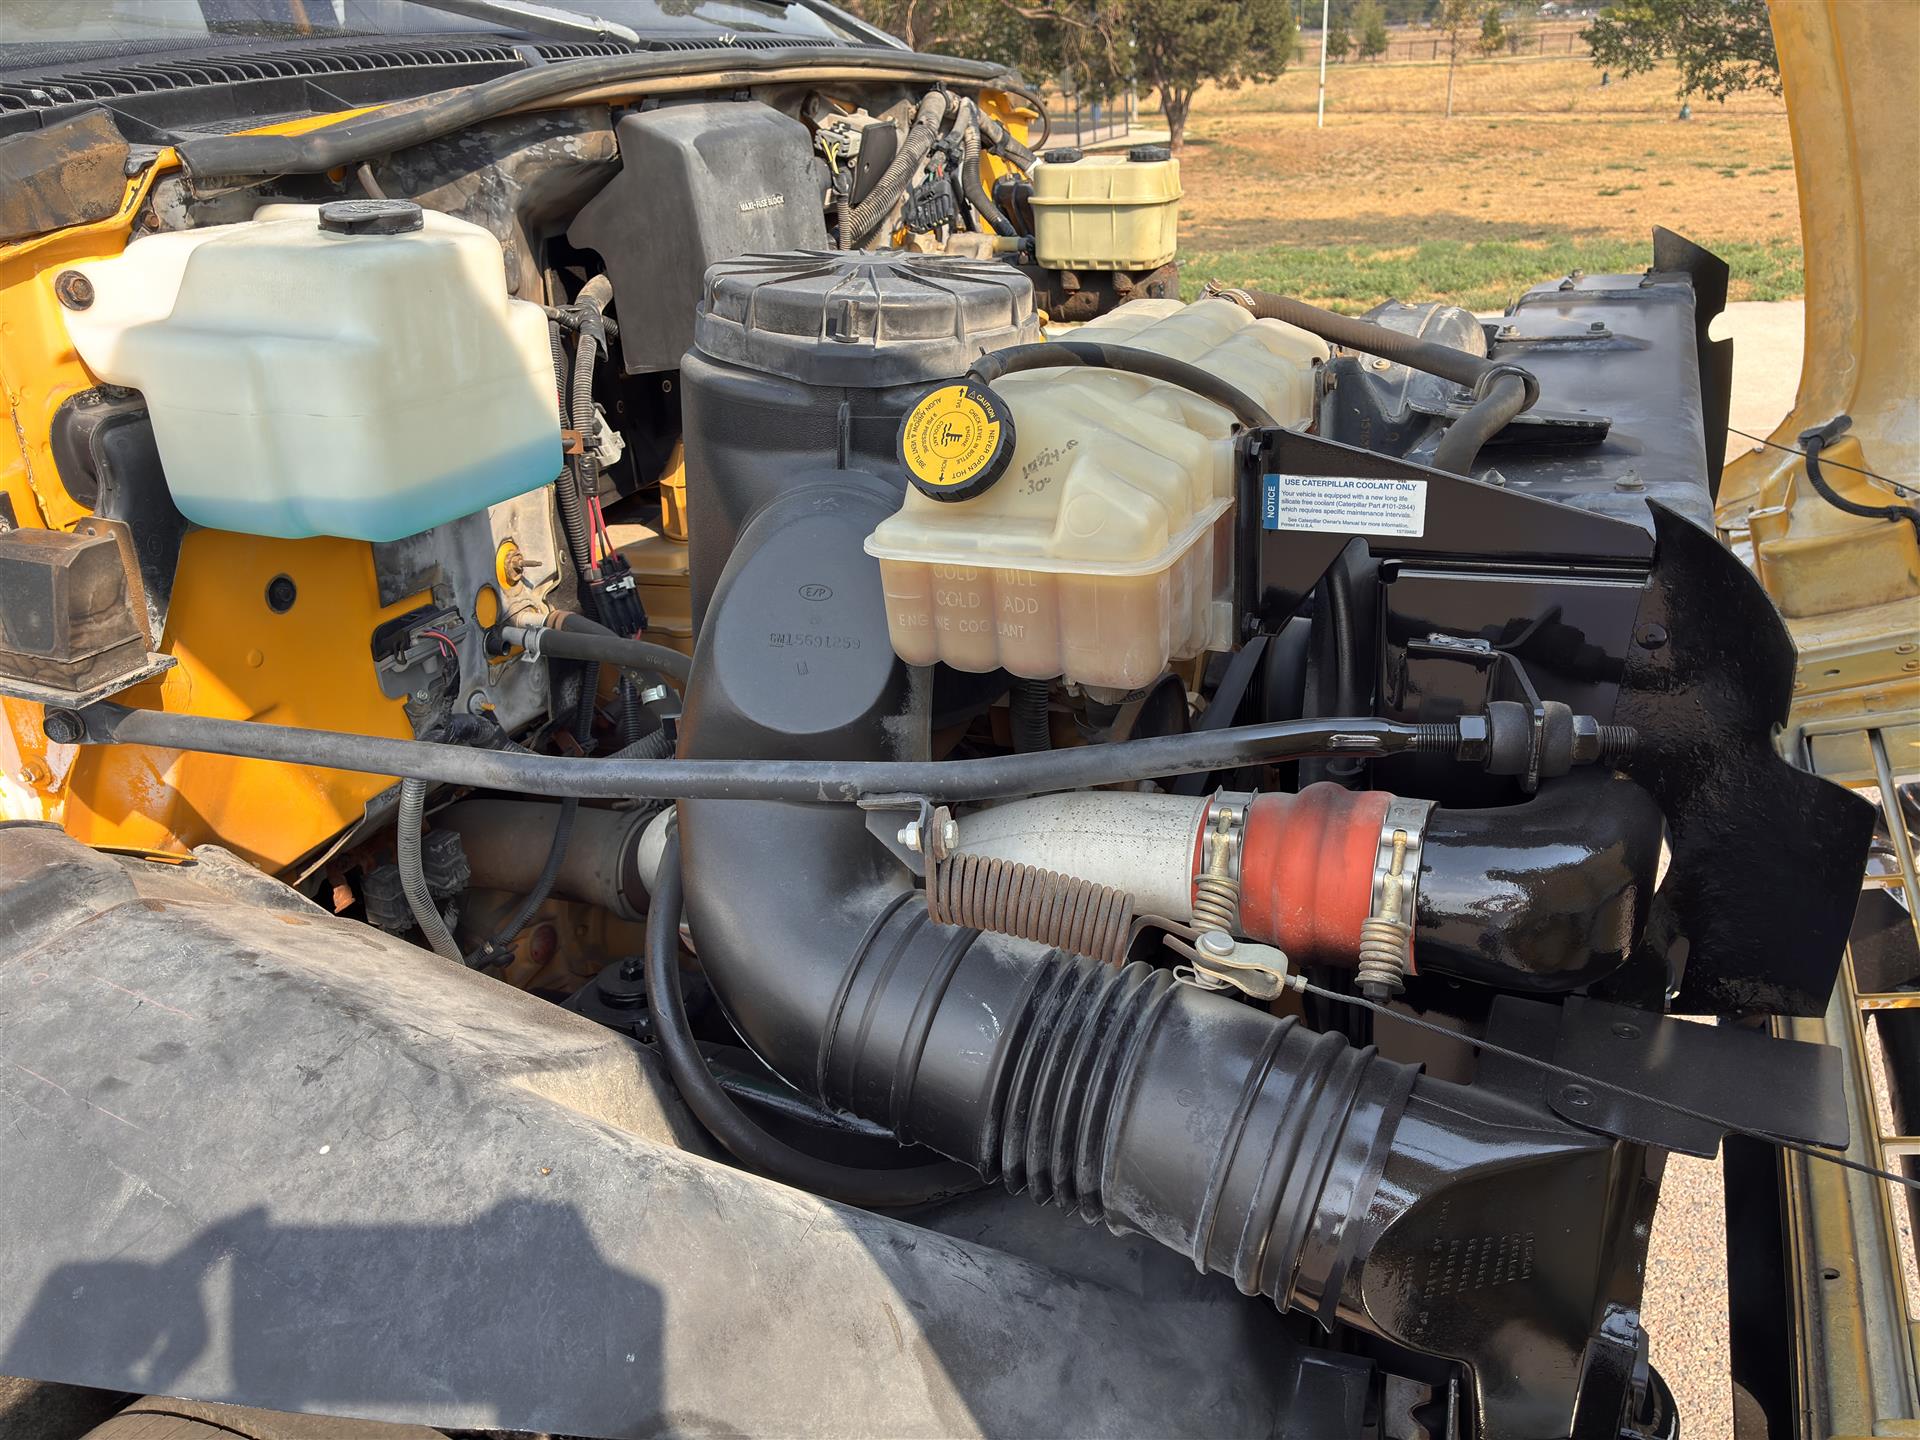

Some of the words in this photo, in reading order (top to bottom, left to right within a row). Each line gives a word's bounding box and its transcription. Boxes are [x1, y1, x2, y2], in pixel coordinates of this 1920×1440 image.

[925, 397, 942, 411] ALIGN
[976, 394, 996, 419] CAUTION
[912, 410, 926, 432] ARROW
[969, 408, 981, 425] CHECK
[921, 425, 930, 454] PRESSURE
[933, 420, 944, 447] COOLANT
[961, 425, 971, 447] ENGINE
[975, 425, 983, 441] LEVEL
[984, 429, 996, 454] NEVER
[915, 455, 926, 469] TUBE
[956, 449, 975, 465] BOTTLE
[968, 454, 985, 472] OPEN
[952, 469, 967, 479] HOT
[1284, 478, 1300, 486] USE
[1301, 479, 1355, 488] CATERPILLAR
[1356, 481, 1395, 490] COOLANT
[1395, 483, 1417, 491] ONLY
[1266, 485, 1276, 518] NOTICE
[1323, 492, 1351, 501] equipped
[1384, 494, 1398, 502] long
[1335, 500, 1368, 509] (Caterpillar
[1381, 502, 1416, 511] #101-2844)
[1298, 507, 1322, 515] requires
[1323, 508, 1345, 516] specific
[1346, 509, 1384, 517] maintenance
[1298, 517, 1322, 525] Caterpillar
[933, 564, 978, 582] COLD
[936, 591, 981, 609] COLD
[1003, 596, 1039, 615] ADD
[898, 613, 951, 632] ENGNE
